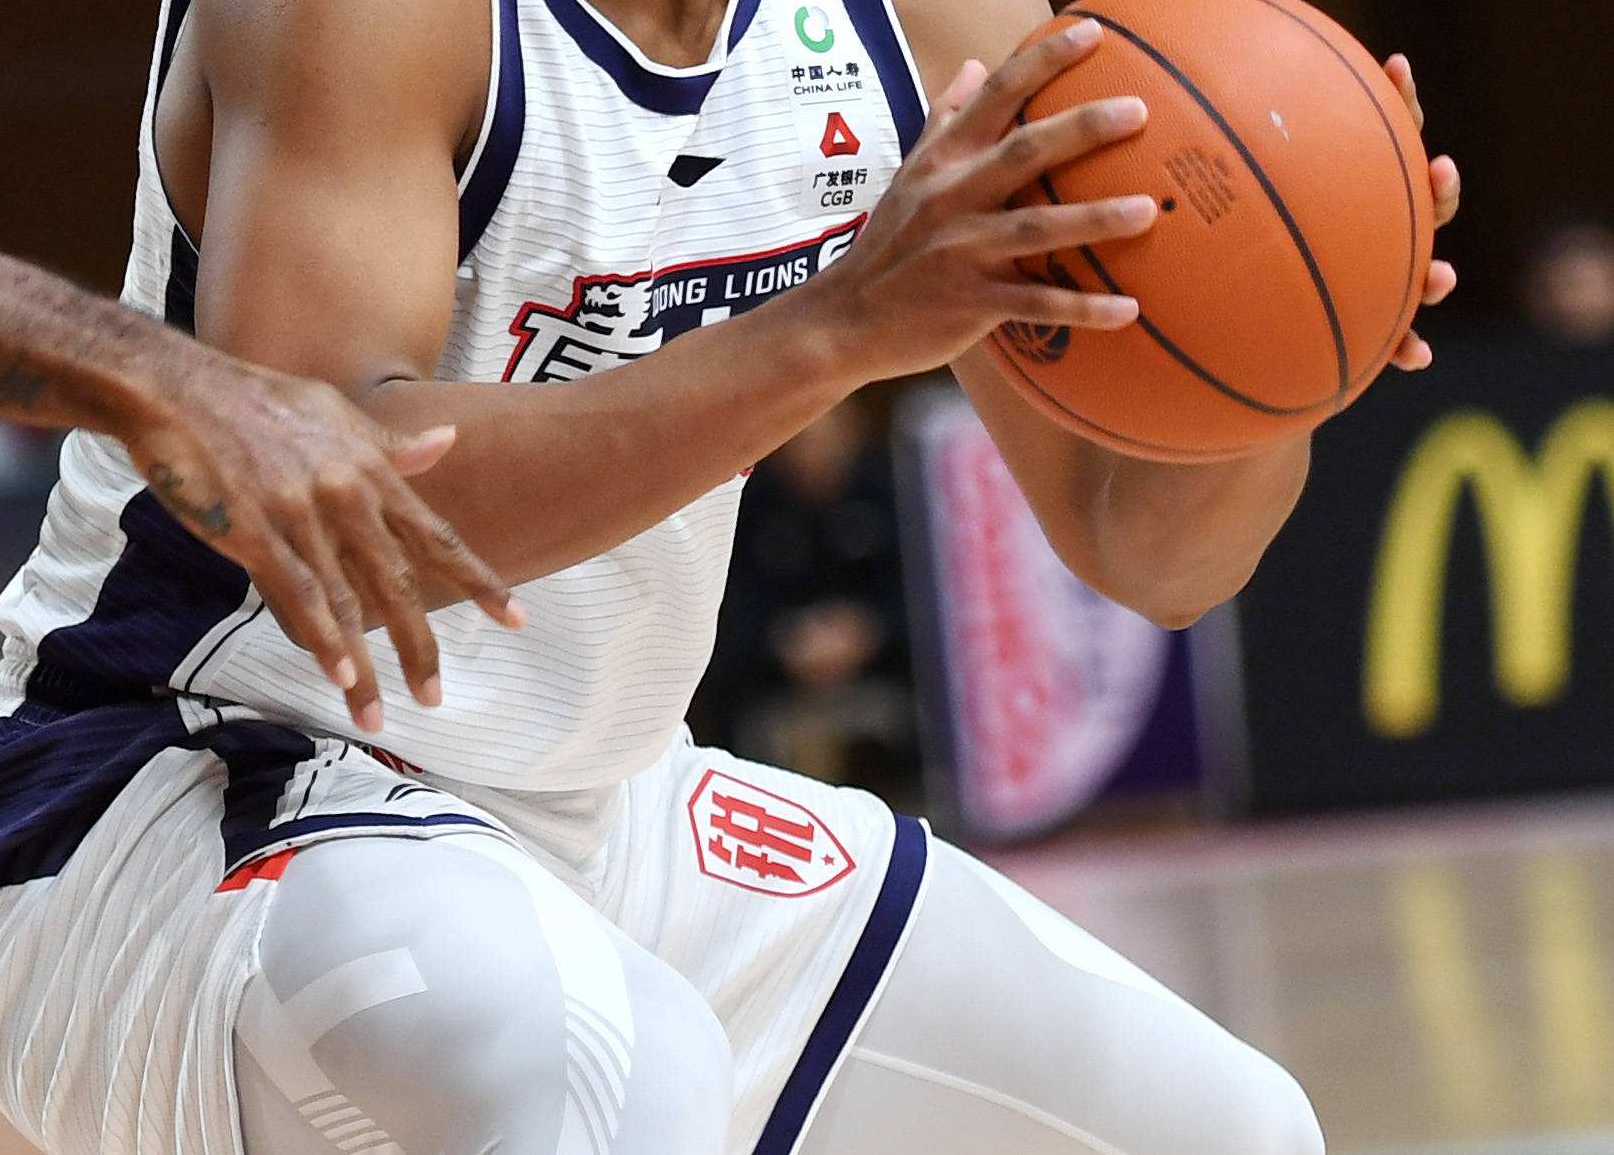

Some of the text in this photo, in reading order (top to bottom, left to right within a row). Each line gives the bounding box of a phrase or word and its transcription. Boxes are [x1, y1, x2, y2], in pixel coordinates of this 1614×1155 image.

[790, 62, 861, 83] 中国人寿
[793, 80, 863, 95] CHINA LIFE
[812, 168, 868, 189] 广发银行
[820, 190, 854, 207] CGB
[724, 257, 809, 300] LIONS
